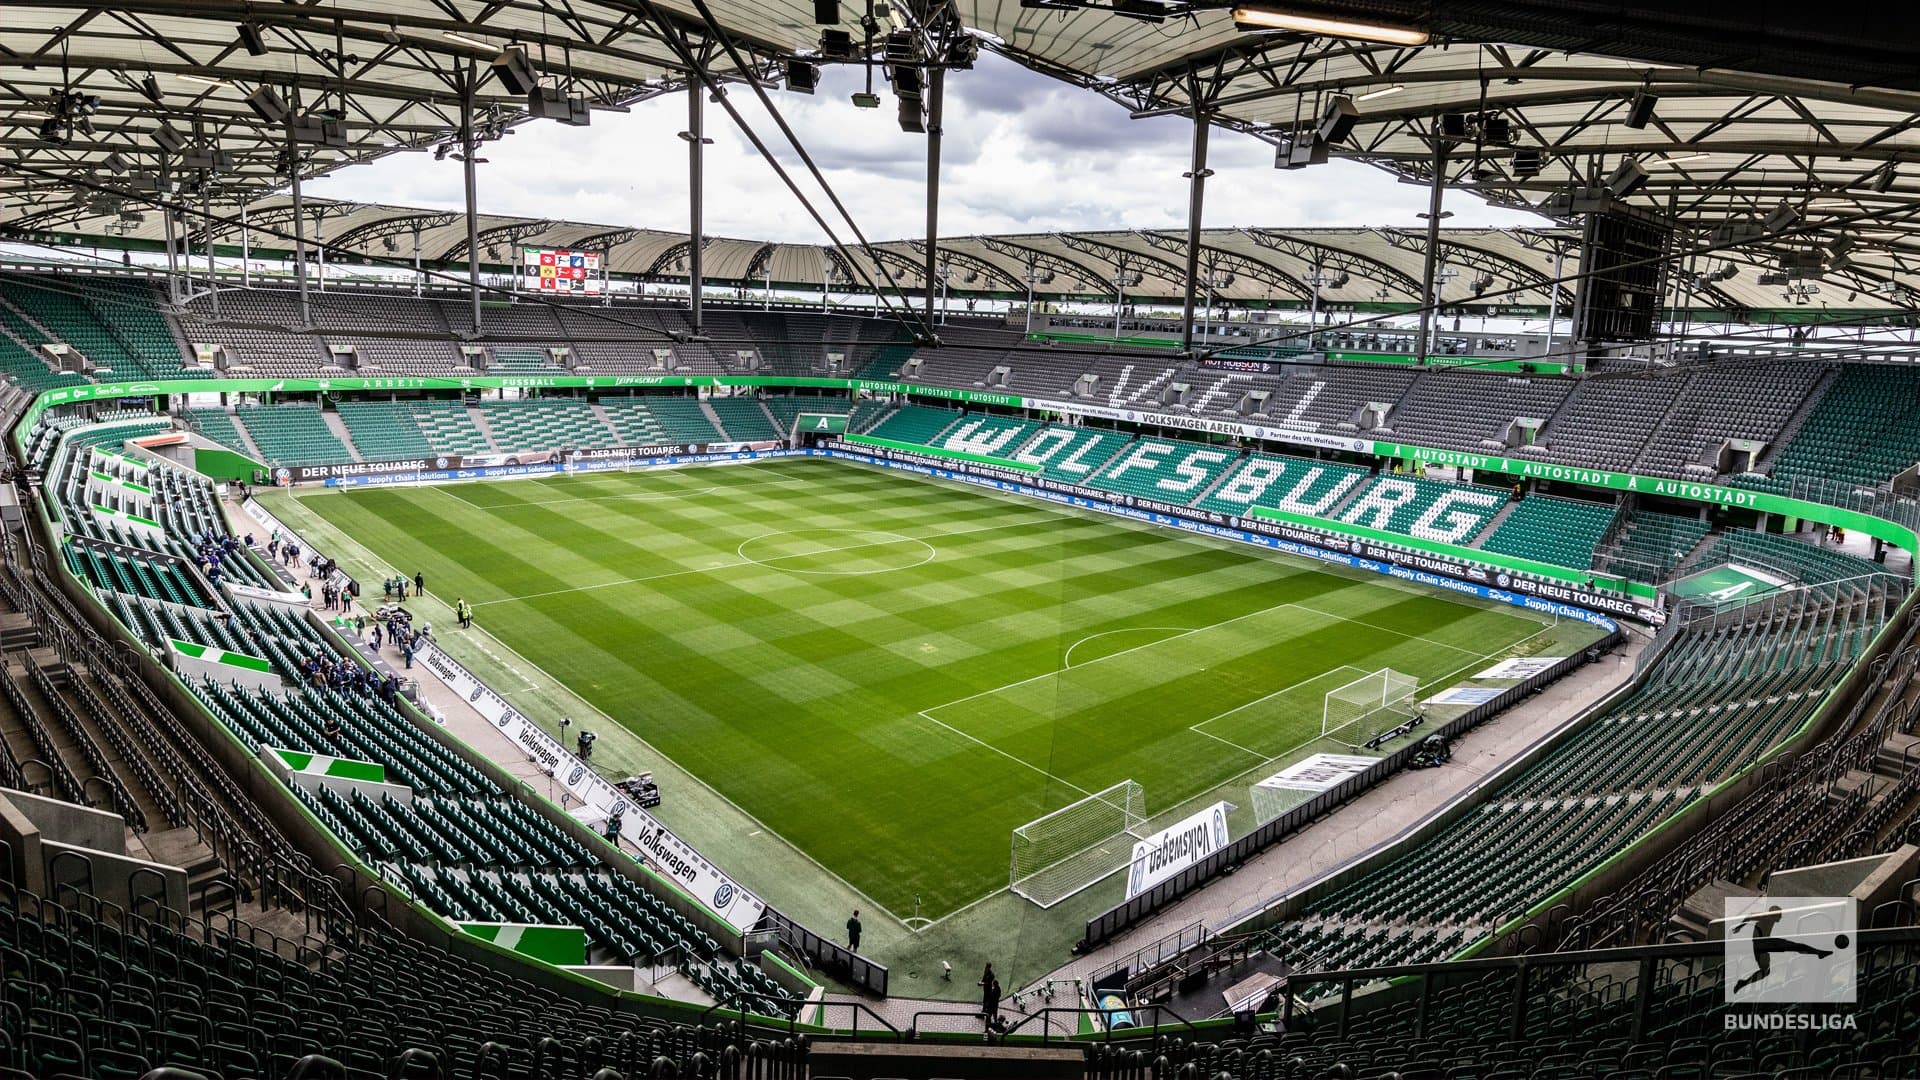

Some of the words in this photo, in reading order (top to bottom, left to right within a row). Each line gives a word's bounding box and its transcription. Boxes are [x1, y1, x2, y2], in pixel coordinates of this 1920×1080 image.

[363, 379, 425, 388] ARBEIT
[502, 378, 556, 386] FUSSBALL
[860, 381, 900, 391] AUTOSTADT
[916, 386, 952, 398] AUTOSTADT
[969, 393, 1010, 404] AUTOSTADT
[1142, 413, 1207, 430] VOLKSWAGEN
[1209, 422, 1245, 435] ARENA
[302, 467, 329, 478] DER
[331, 464, 366, 476] NEUE
[484, 468, 507, 477] Supply
[508, 467, 527, 475] Chain
[527, 465, 556, 474] Solutions
[676, 456, 694, 464] Supply
[367, 476, 393, 484] Supply
[394, 474, 415, 482] Chain
[944, 419, 1499, 546] WOLFSBURG
[968, 466, 980, 475] DER
[980, 468, 996, 478] NEUE
[1413, 448, 1488, 469] AUTOSTADT
[1523, 462, 1611, 486] AUTOSTADT
[1655, 481, 1758, 507] AUTOSTADT
[1045, 481, 1058, 490] DER
[1057, 483, 1075, 493] NEUE
[1074, 487, 1105, 499] TOUAREG.
[1093, 502, 1110, 512] Supply
[1110, 505, 1125, 515] Chain
[1125, 508, 1150, 520] Solutions
[1137, 499, 1151, 508] DER
[1152, 502, 1171, 513] NEUE
[1171, 506, 1208, 520] TOUAREG.
[1178, 520, 1198, 531] Supply
[1198, 524, 1215, 534] Chain
[1216, 527, 1245, 540] Solutions
[1241, 519, 1258, 530] DER
[1258, 523, 1280, 535] NEUE
[1281, 527, 1322, 544] TOUAREG.
[1277, 541, 1299, 553] Supply
[1300, 546, 1319, 557] Chain
[1320, 550, 1352, 565] Solutions
[1367, 547, 1386, 559] DER
[1387, 551, 1413, 565] NEUE
[1414, 557, 1465, 577] TOUAREG.
[1388, 566, 1416, 581] Supply
[1416, 573, 1439, 586] Chain
[1439, 577, 1478, 595] Solutions
[1513, 578, 1537, 593] DER
[1538, 584, 1570, 600] NEUE
[1572, 591, 1636, 616] TOUAREG.
[1524, 598, 1556, 614] Supply
[1558, 605, 1585, 620] Chain
[1586, 611, 1615, 634] Solutions
[427, 652, 457, 682] Volkswagen
[518, 727, 559, 768] Volkswagen
[638, 825, 697, 883] Volkswagen
[1149, 821, 1210, 875] Volkswagen
